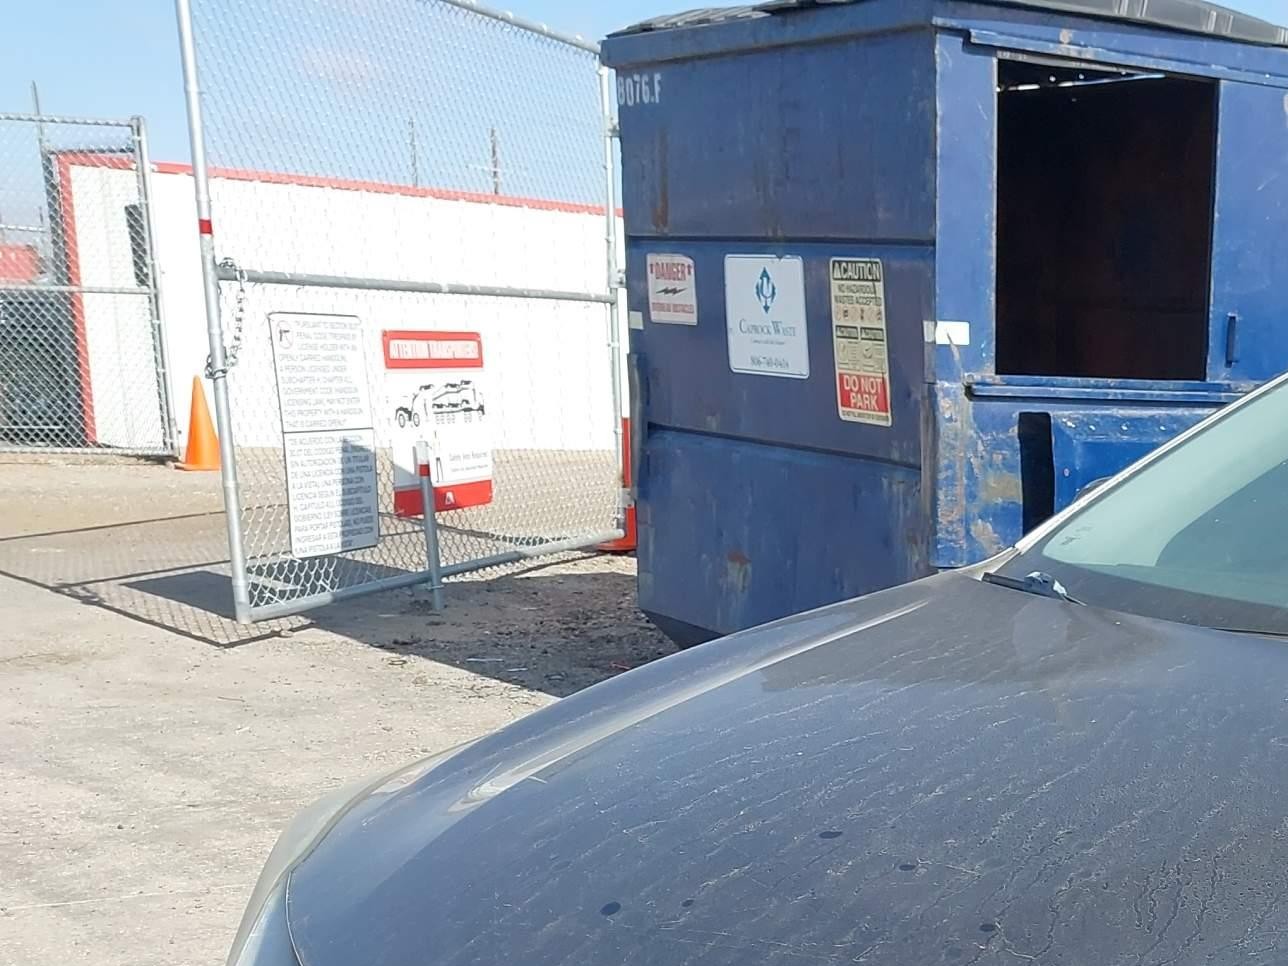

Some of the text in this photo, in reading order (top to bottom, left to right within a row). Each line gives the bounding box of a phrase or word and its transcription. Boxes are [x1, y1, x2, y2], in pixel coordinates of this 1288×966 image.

[840, 262, 880, 280] CAUTION
[843, 375, 883, 395] DO NOT
[850, 391, 879, 411] PARK
